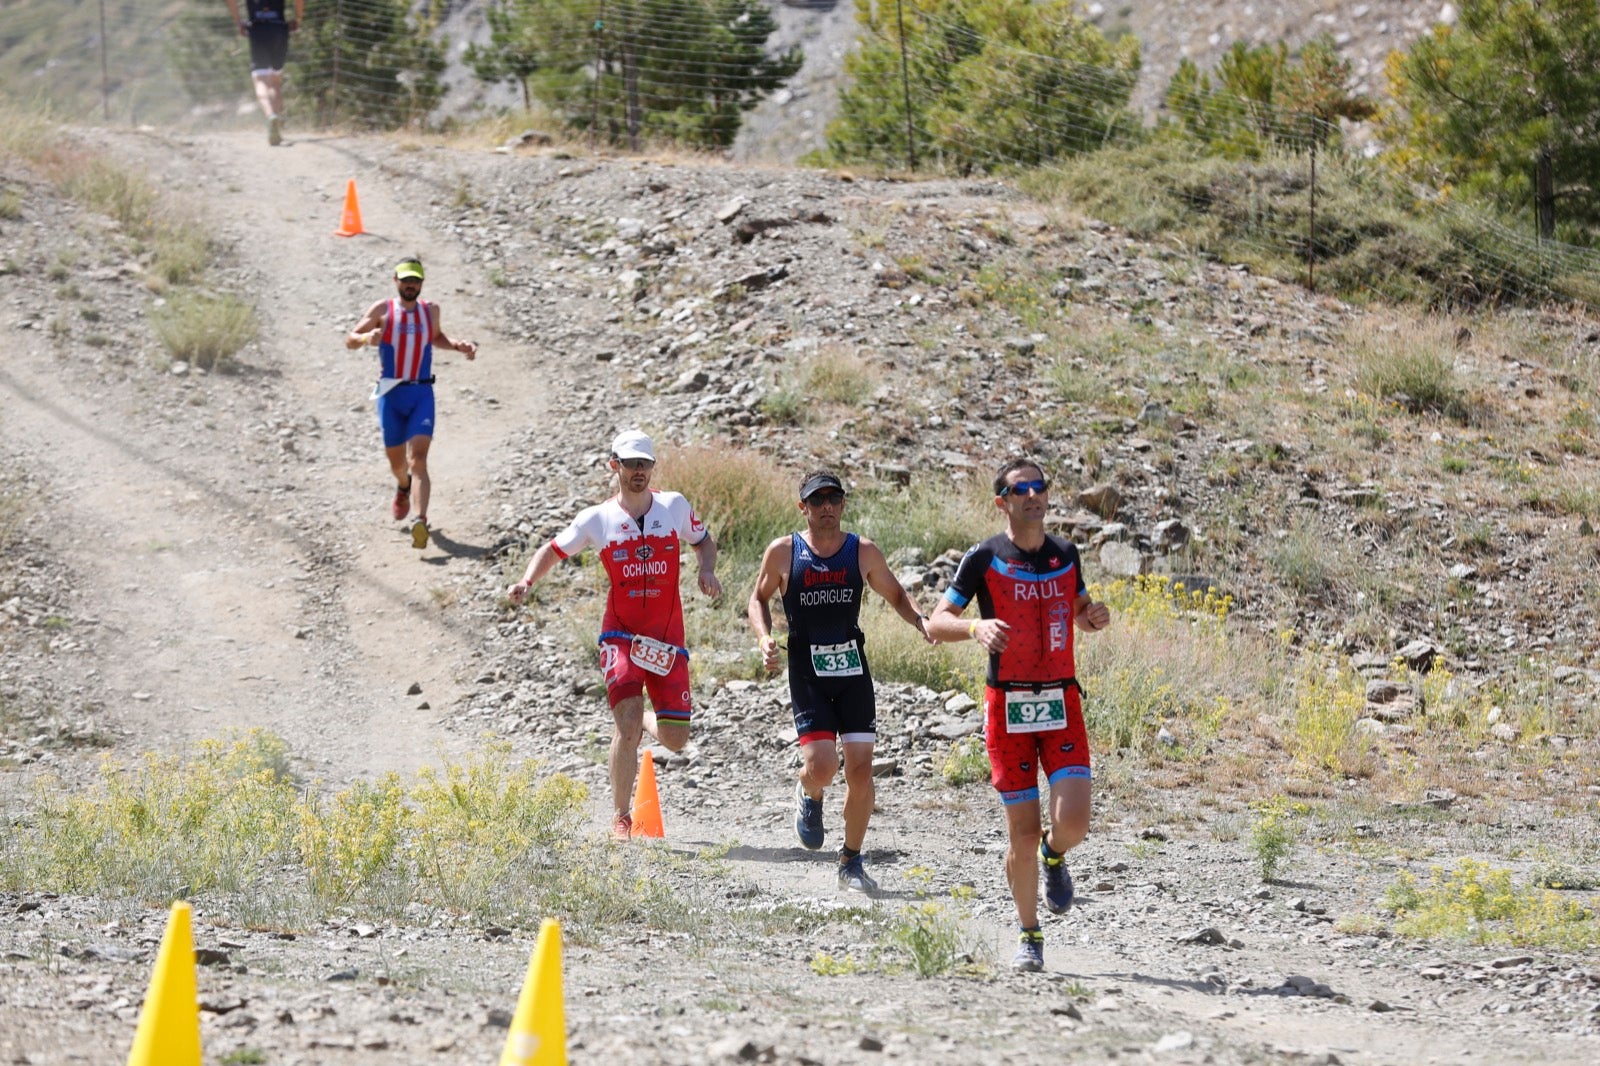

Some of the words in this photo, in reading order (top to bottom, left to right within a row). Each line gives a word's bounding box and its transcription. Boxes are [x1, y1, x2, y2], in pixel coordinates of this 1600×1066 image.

[622, 560, 667, 578] OCHANDO
[799, 588, 854, 606] RODRIGUEZ
[1014, 578, 1064, 601] RAÚL
[635, 644, 670, 667] 353
[824, 653, 849, 671] 33
[1020, 702, 1052, 722] 92
